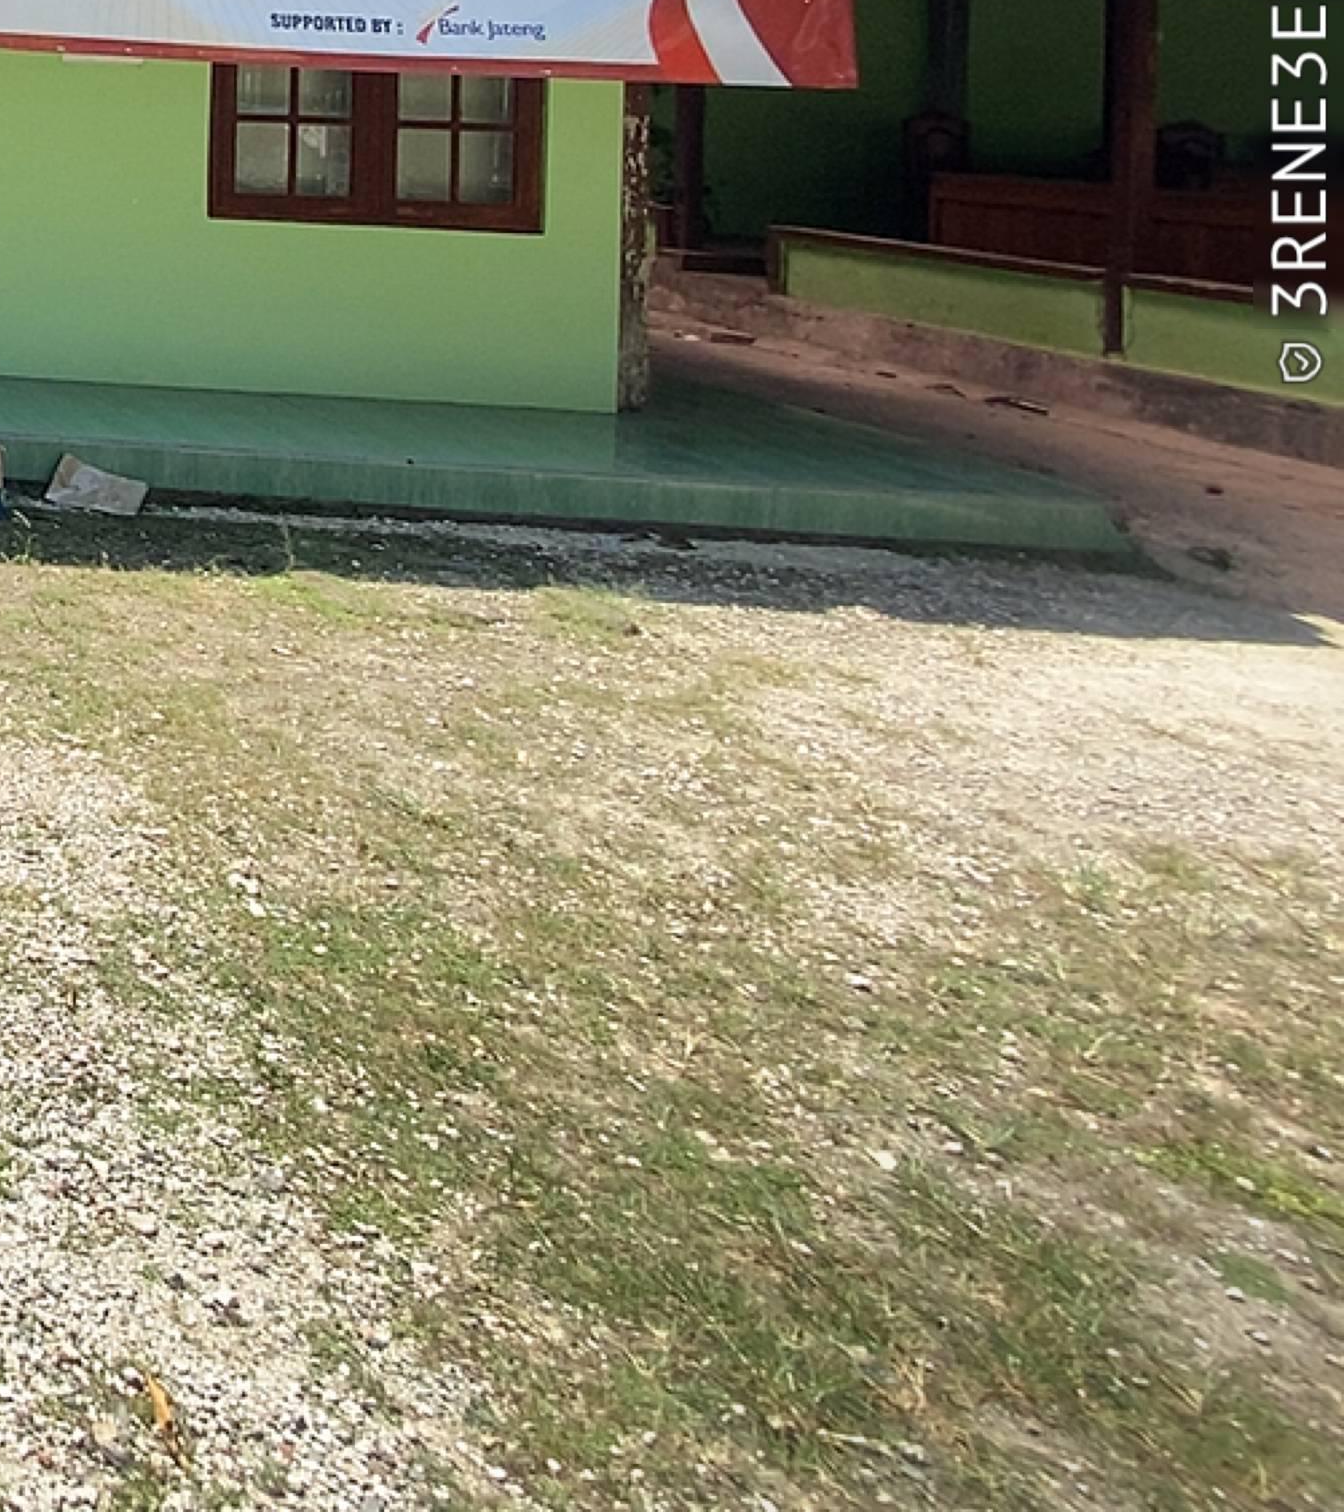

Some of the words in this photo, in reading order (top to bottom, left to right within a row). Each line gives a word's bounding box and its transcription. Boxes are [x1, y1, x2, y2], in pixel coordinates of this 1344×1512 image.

[270, 13, 367, 33] SUPPORTED
[372, 18, 392, 34] BY
[439, 18, 484, 36] Bank
